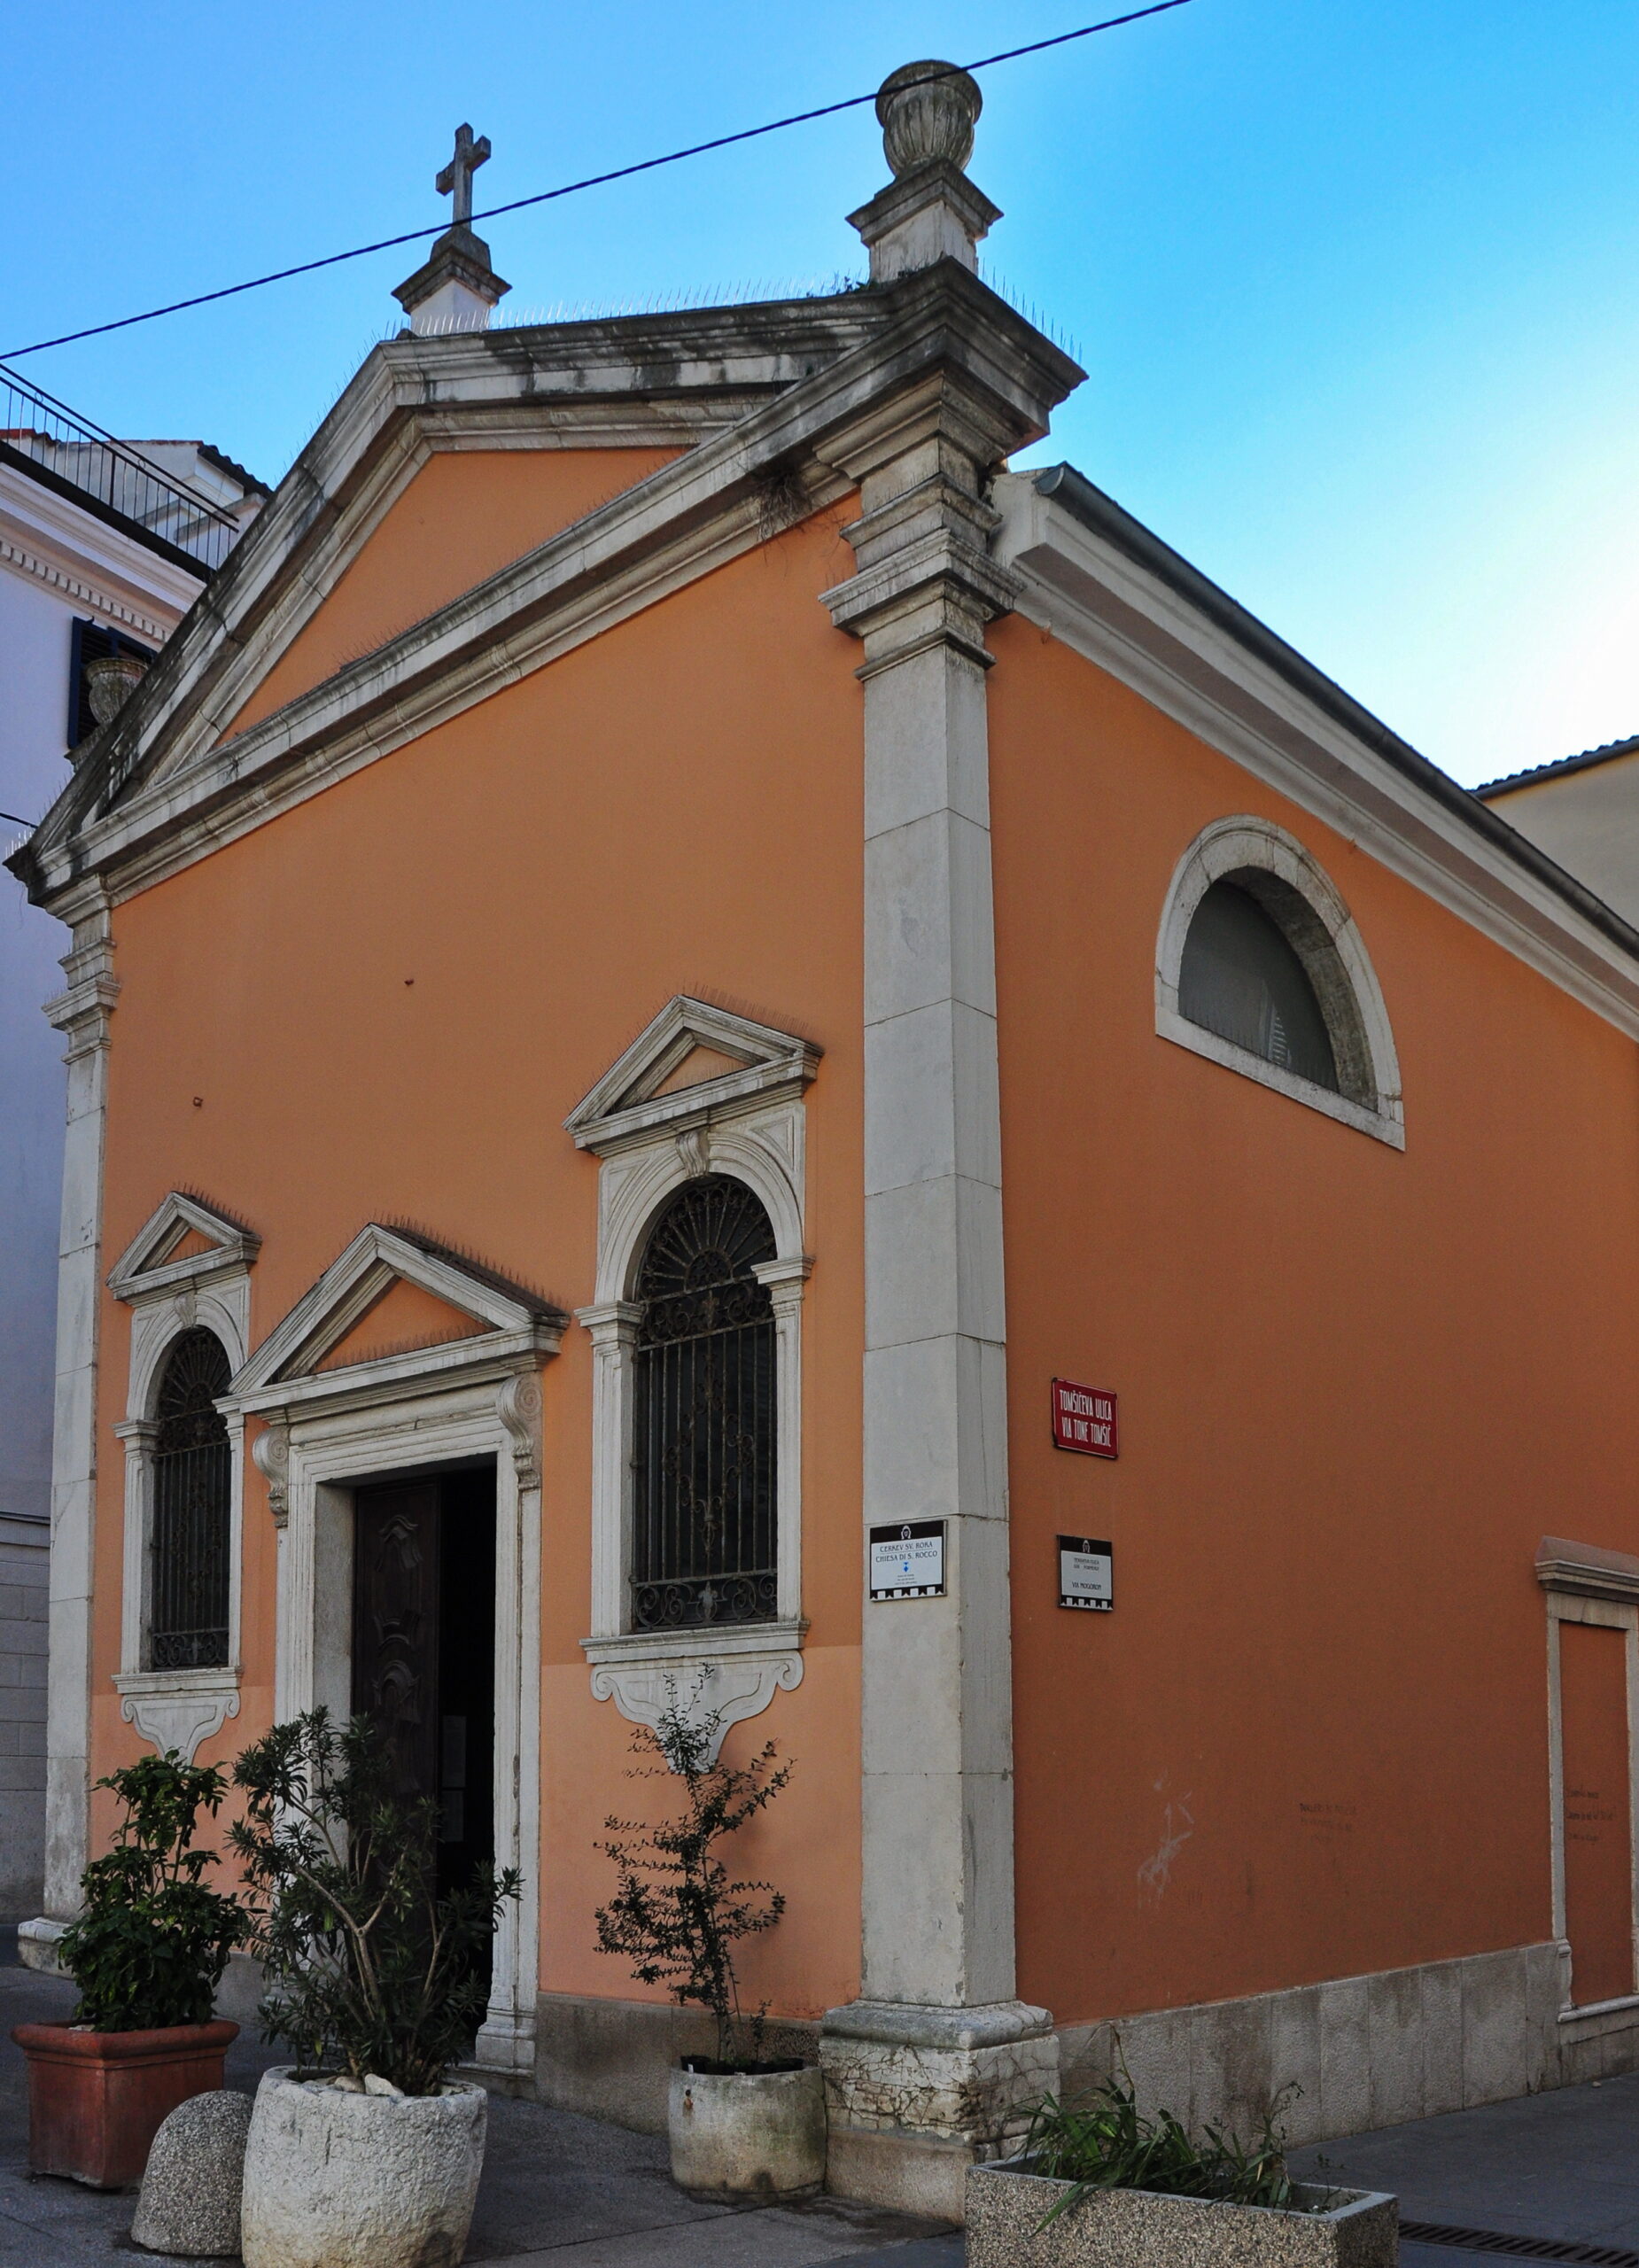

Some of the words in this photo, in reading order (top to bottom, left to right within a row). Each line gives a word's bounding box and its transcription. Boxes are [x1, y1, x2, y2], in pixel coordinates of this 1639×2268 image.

[1059, 1389, 1093, 1417] TOMŠIČEVA
[1095, 1398, 1113, 1422] ULICA
[1061, 1417, 1072, 1439] VIA
[1073, 1419, 1089, 1442] TONE
[1090, 1423, 1112, 1448] TOMŠIČ
[875, 1554, 898, 1563] CHIESA
[915, 1550, 938, 1559] ROCCO
